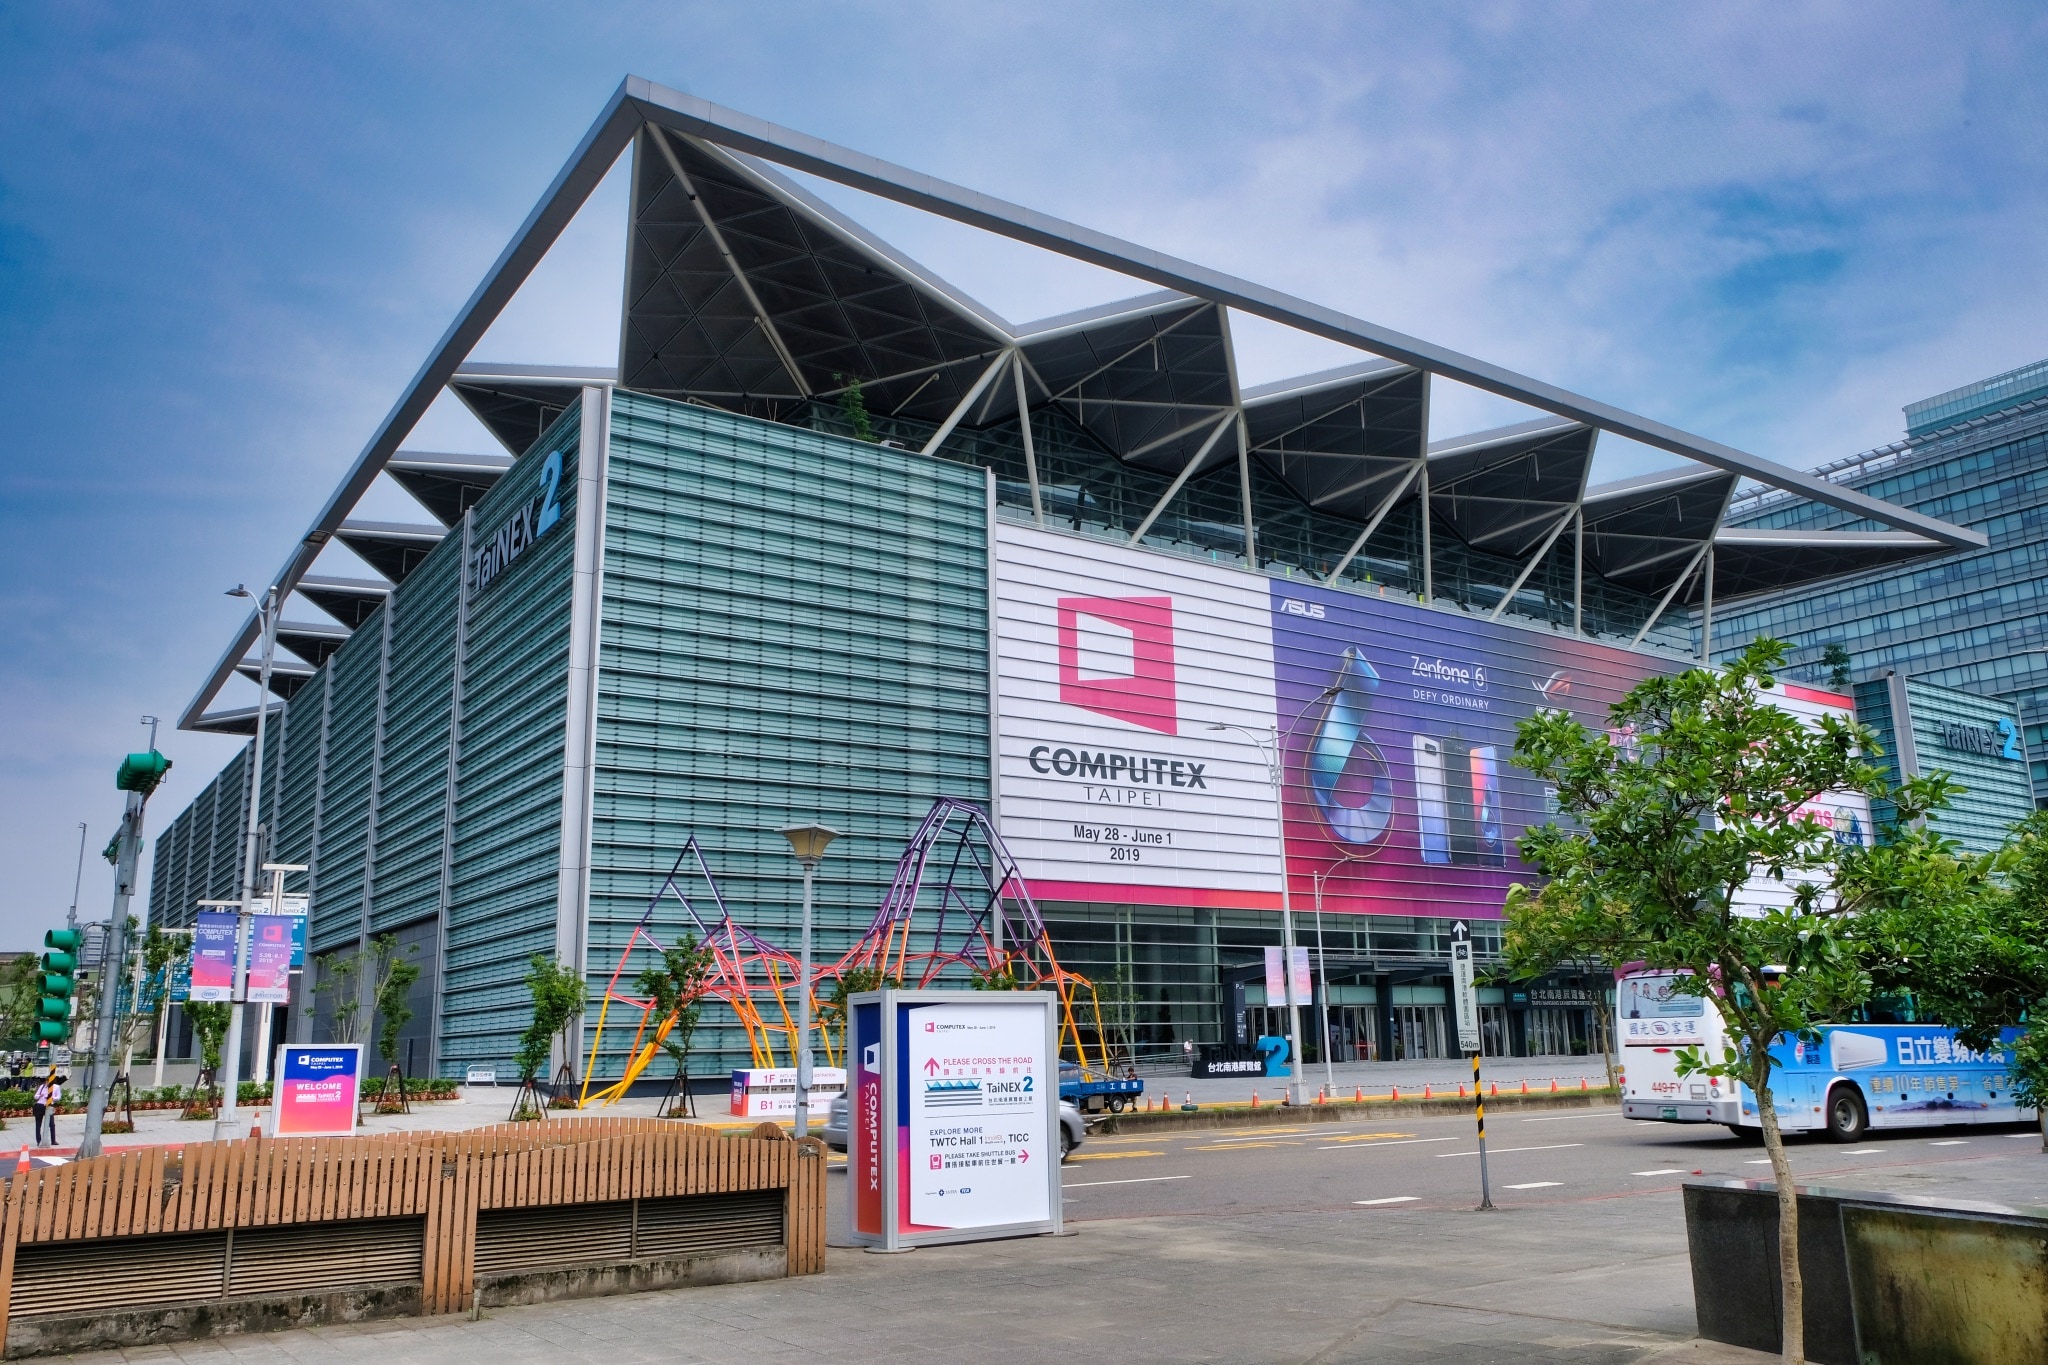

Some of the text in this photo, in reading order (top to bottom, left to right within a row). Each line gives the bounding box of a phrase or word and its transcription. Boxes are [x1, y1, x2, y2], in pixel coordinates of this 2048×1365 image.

[474, 450, 563, 591] TaiNEX 2
[1280, 599, 1325, 619] ASUS
[1410, 655, 1469, 684] Zenfone
[1413, 689, 1489, 710] DEFY ORDINARY
[1939, 717, 2021, 760] TaiNEX 2
[1029, 745, 1207, 789] COMPUTEX
[1083, 786, 1161, 806] TAIPEI
[1073, 825, 1100, 842] May
[1104, 827, 1119, 841] 28
[1131, 829, 1162, 844] June
[1167, 832, 1172, 844] 1
[1110, 847, 1140, 861] 2019
[198, 928, 233, 936] COMPUTEX
[253, 990, 283, 999] Micron
[1630, 1021, 1696, 1035] 國光 客運
[1460, 1040, 1479, 1049] 540m
[943, 1058, 970, 1066] PLEASE
[972, 1057, 996, 1065] CROSS
[1013, 1056, 1033, 1064] ROAD
[1256, 1036, 1291, 1077] 2
[1207, 1061, 1261, 1073] 台北南港展覽館
[763, 1074, 775, 1084] 1F
[986, 1075, 1034, 1093] TaiNEX 2
[1651, 1081, 1683, 1093] 449-FY
[760, 1100, 773, 1110] B1
[869, 1082, 878, 1191] COMPUTEX
[929, 1128, 961, 1136] EXPLORE
[929, 1133, 1029, 1147] TWTC Hall 1 TICC
[944, 1152, 964, 1160] PLEASE
